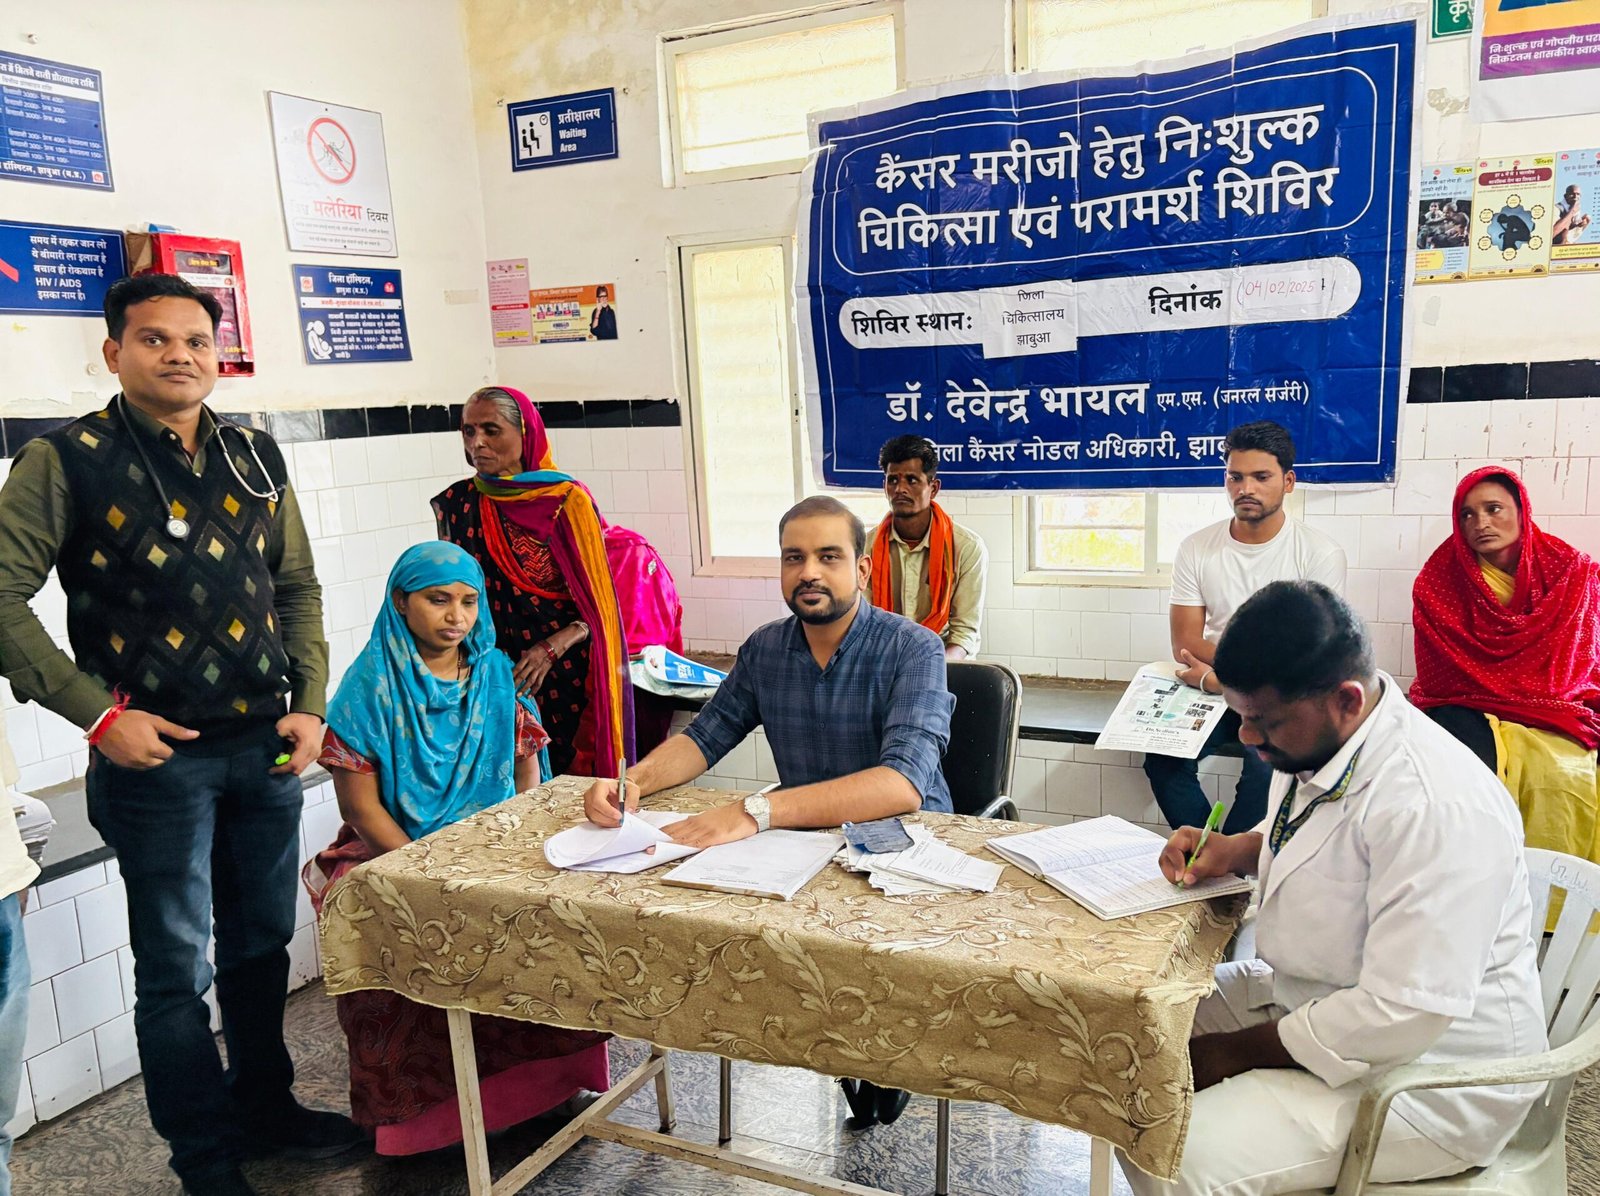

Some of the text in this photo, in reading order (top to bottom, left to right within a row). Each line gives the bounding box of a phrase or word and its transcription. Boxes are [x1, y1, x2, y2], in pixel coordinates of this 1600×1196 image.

[1489, 52, 1532, 64] निकटतम
[558, 108, 600, 124] प्रतीक्षालय
[559, 128, 586, 140] Waiting
[560, 143, 577, 153] Area
[875, 152, 960, 194] कैंसर
[970, 132, 1081, 185] मरीजो
[1090, 125, 1145, 179] हेतु
[314, 196, 364, 220] मलेरिया
[366, 208, 388, 222] दिवस
[858, 160, 1340, 253] चिकित्सा एवं परामर्श शिविर
[30, 236, 49, 245] समय
[59, 238, 78, 248] रहकर
[80, 240, 95, 249] जान
[96, 239, 107, 249] लो
[40, 248, 65, 260] बीमारी
[79, 254, 100, 263] इलाज
[33, 264, 104, 277] बचाव ही रोकथाम है
[328, 272, 344, 283] जिला
[36, 277, 52, 286] HIV
[60, 278, 82, 288] AIDS
[37, 290, 60, 300] इसका
[62, 292, 76, 300] नाम
[1148, 284, 1223, 315] दिनांक
[851, 309, 911, 336] शिविर
[1002, 308, 1064, 326] चिकित्सालय
[1016, 332, 1050, 348] झाबुआ
[886, 378, 1309, 424] डॉ. देवेन्द्र भायल एम.एस. (जनरल सर्जरी)
[968, 436, 1017, 462] कैंसर
[1022, 436, 1081, 461] नोडल
[1086, 430, 1180, 460] अधिकारी,
